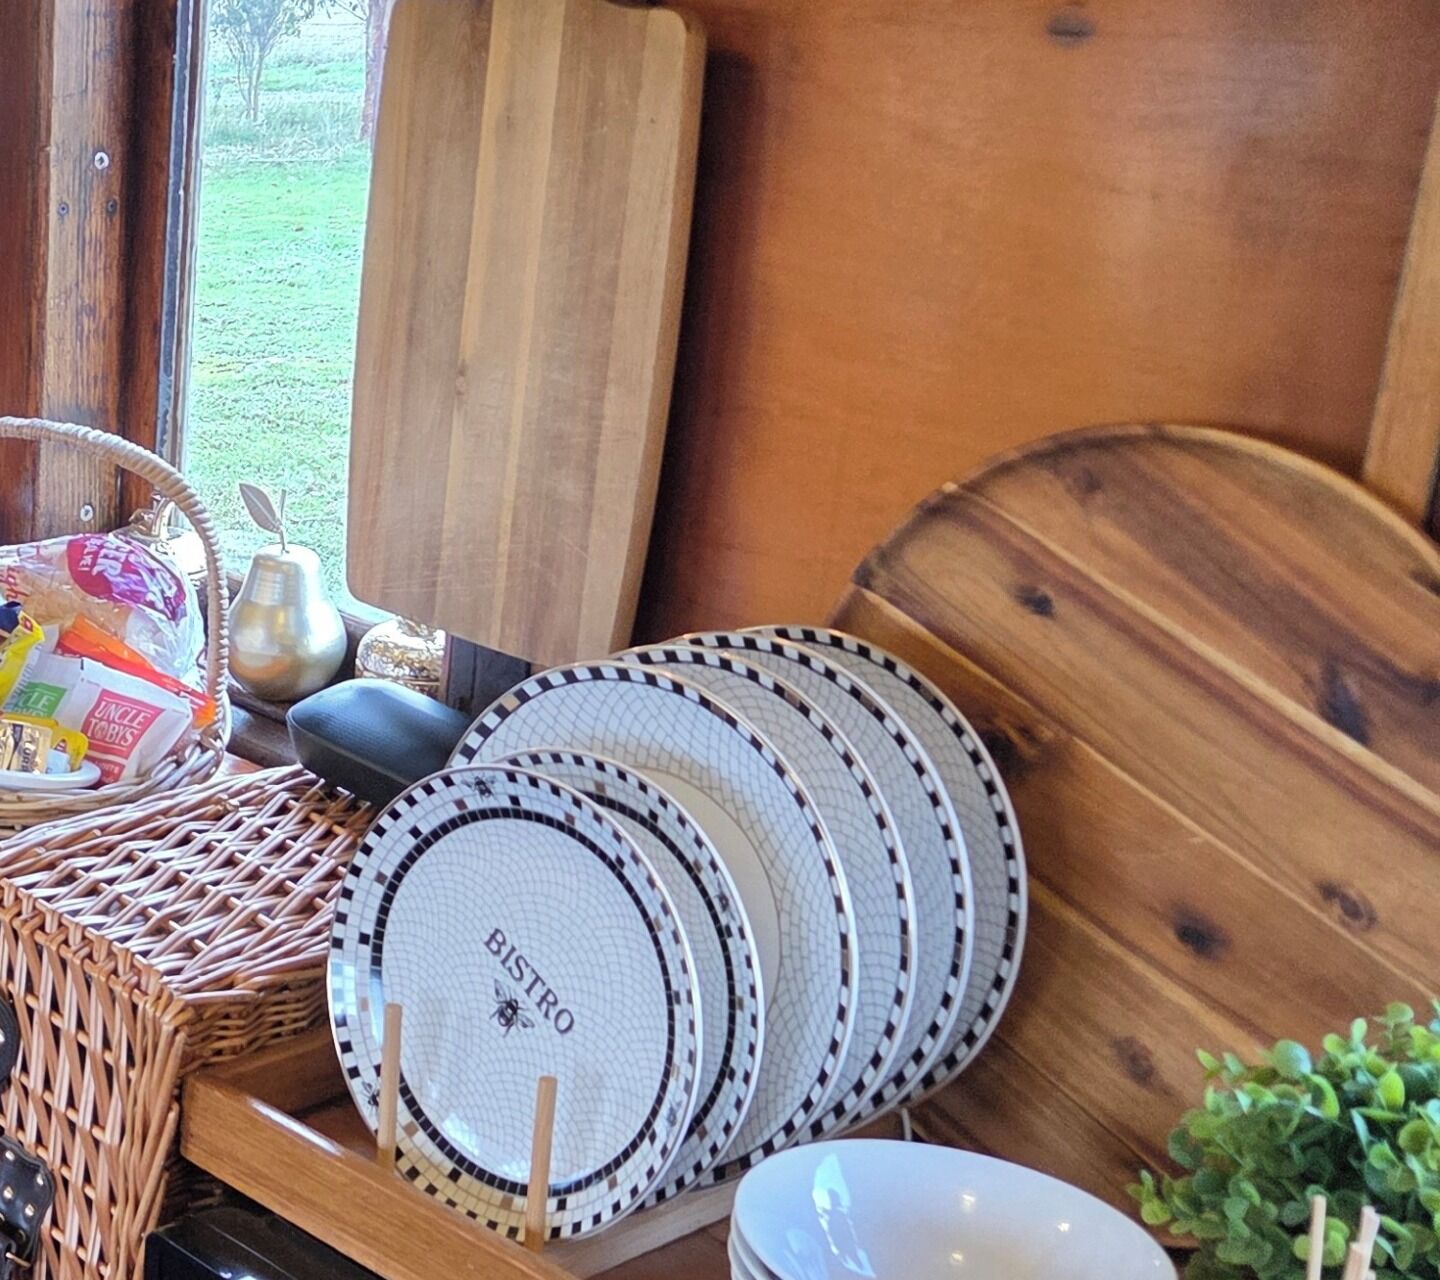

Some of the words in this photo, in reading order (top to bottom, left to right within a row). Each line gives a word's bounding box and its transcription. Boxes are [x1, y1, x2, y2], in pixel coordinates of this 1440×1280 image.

[94, 700, 151, 729] UNCLE
[89, 717, 139, 746] TOBYS
[484, 928, 575, 1035] BISTRO
